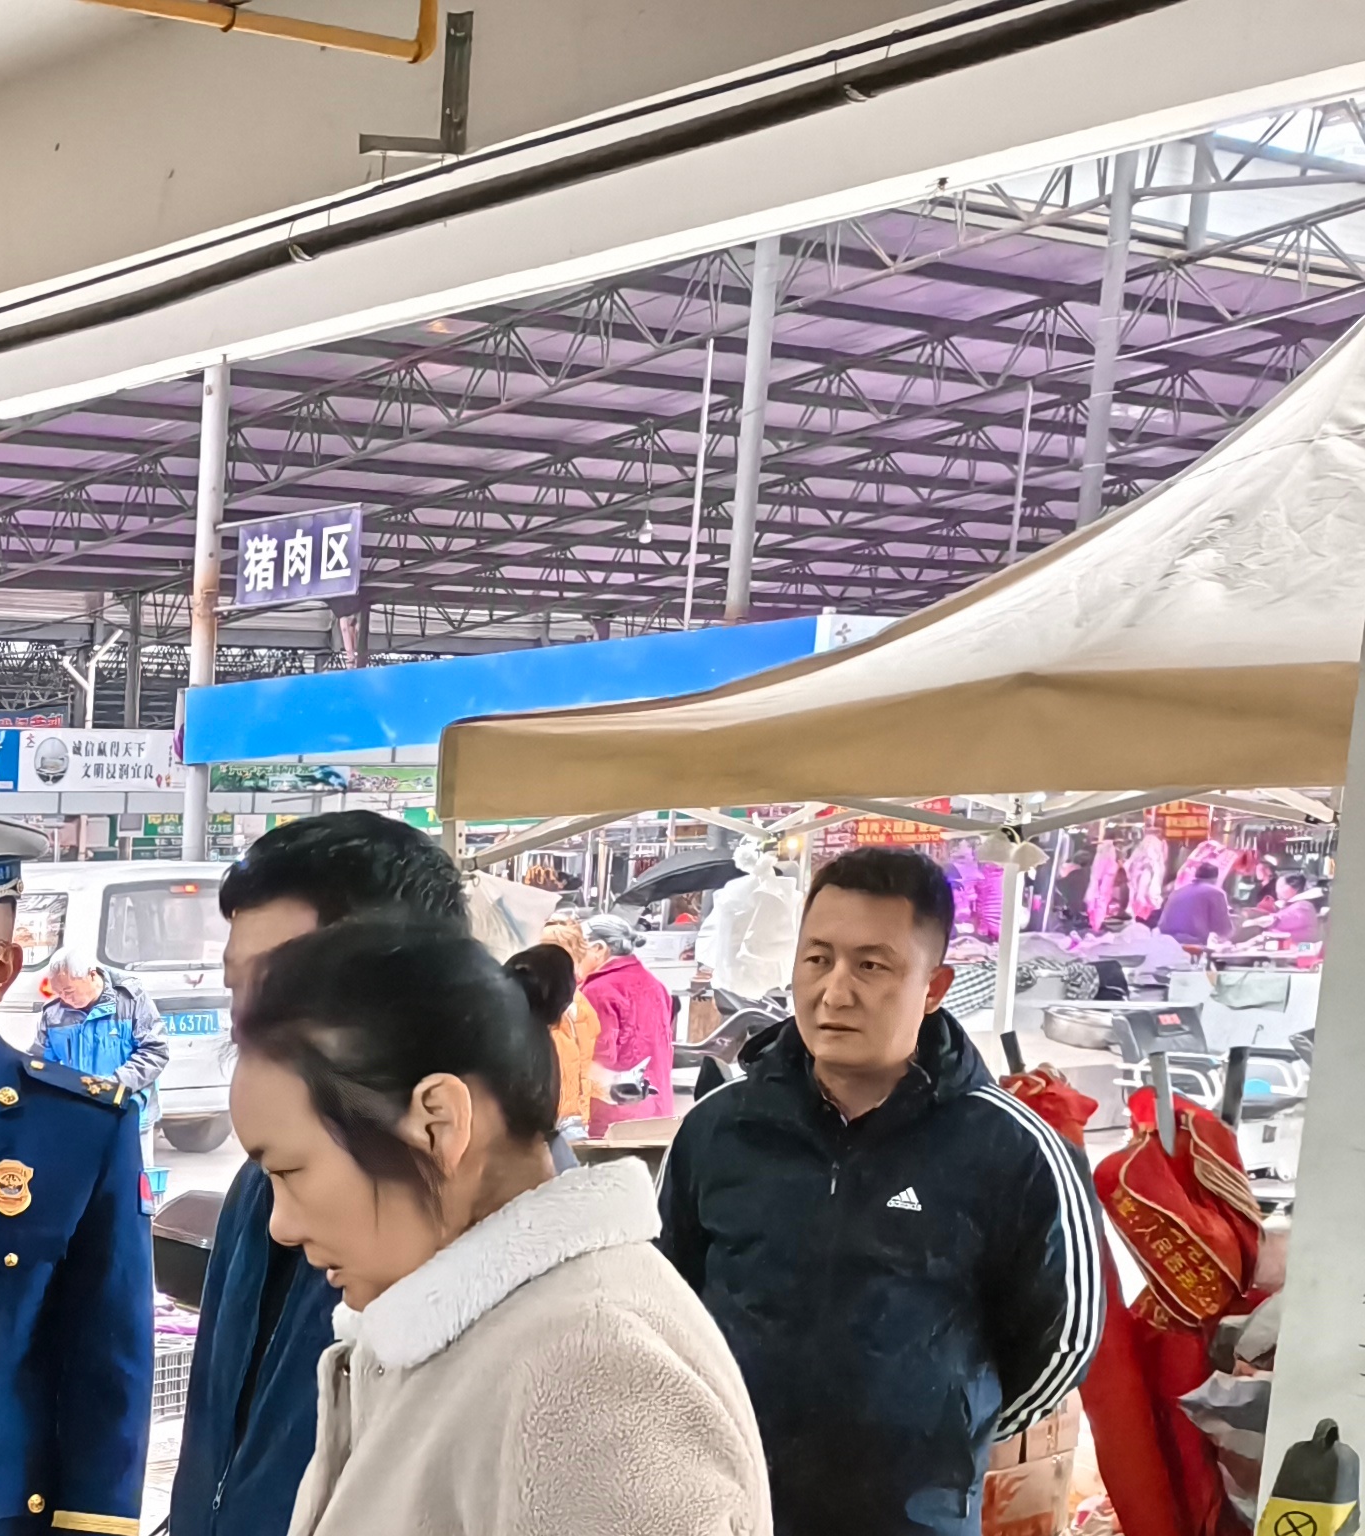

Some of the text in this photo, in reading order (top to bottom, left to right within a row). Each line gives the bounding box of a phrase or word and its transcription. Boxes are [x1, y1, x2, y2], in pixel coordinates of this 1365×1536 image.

[243, 523, 352, 593] 猪肉区
[81, 762, 155, 780] 文明浸润宜良
